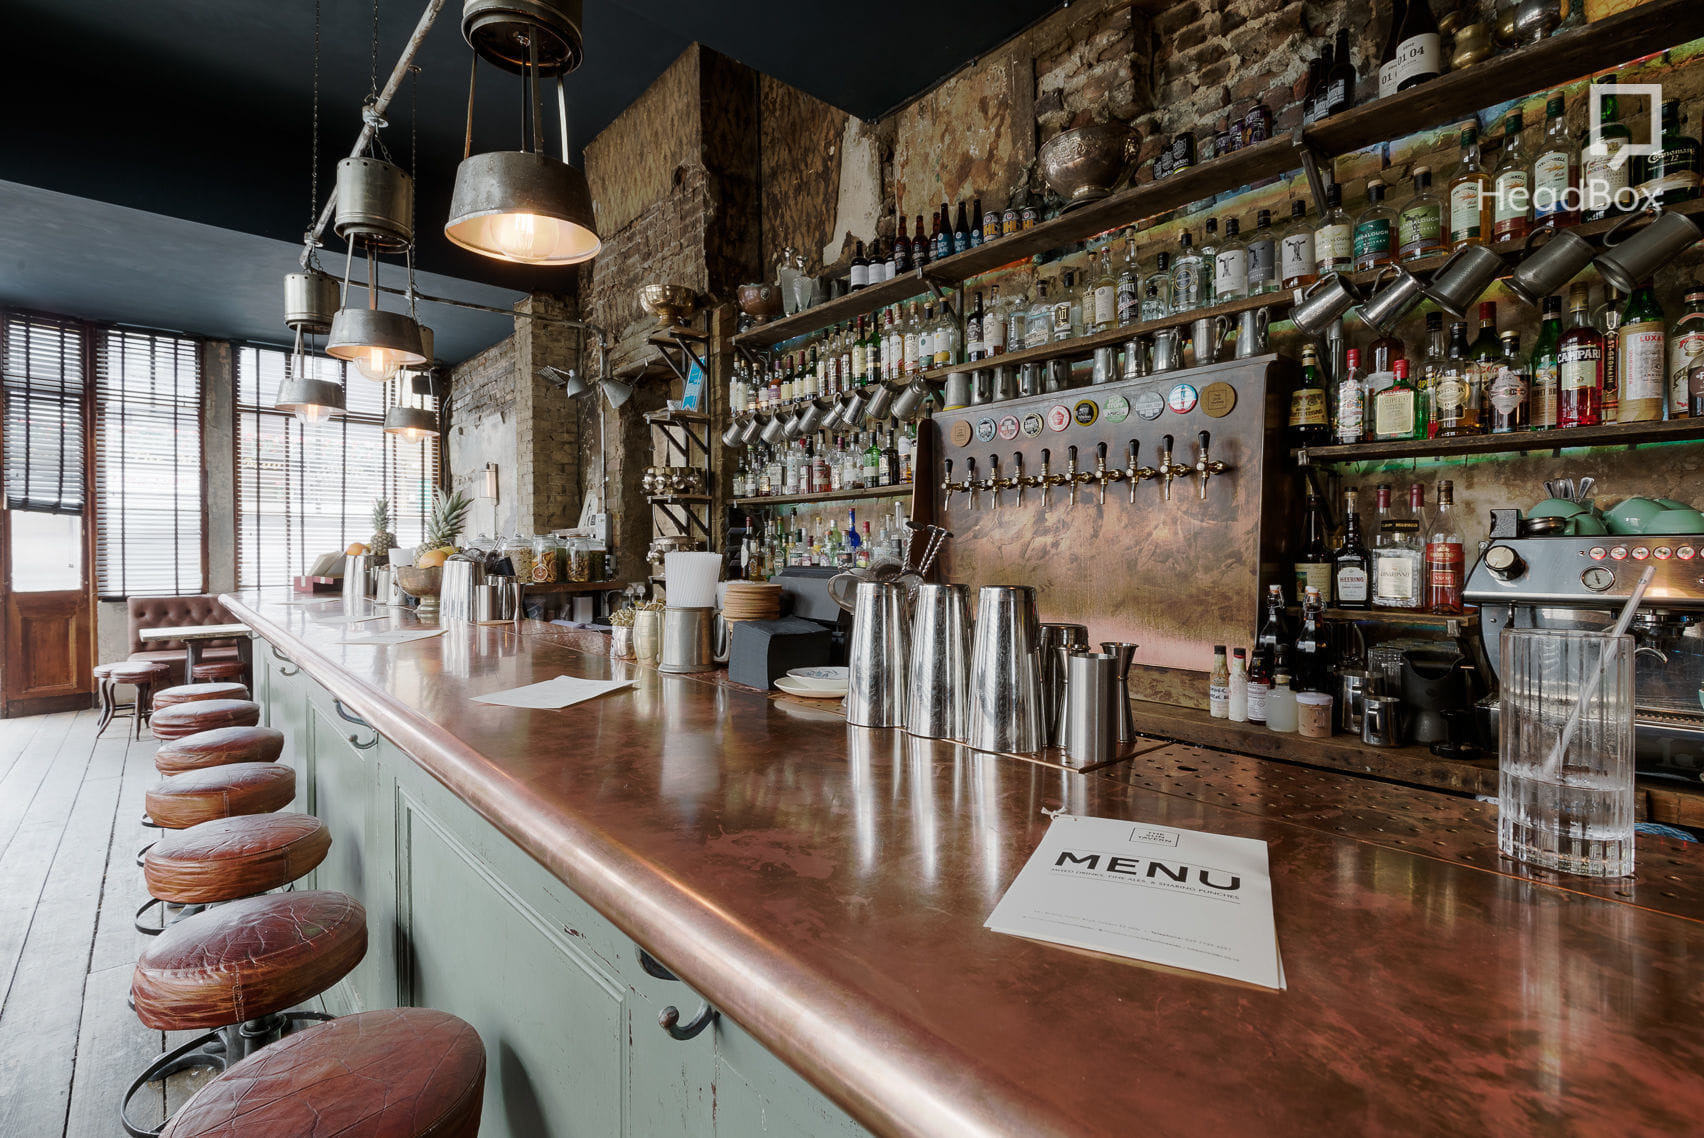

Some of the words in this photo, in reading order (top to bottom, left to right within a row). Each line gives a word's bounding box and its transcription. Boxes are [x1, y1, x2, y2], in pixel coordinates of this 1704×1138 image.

[1409, 45, 1425, 58] 04
[1557, 349, 1601, 364] CAMPARI
[1137, 835, 1172, 843] TAVERN
[1054, 851, 1241, 891] MENU
[1158, 881, 1196, 892] SHARING
[1198, 888, 1240, 900] PUNCHES
